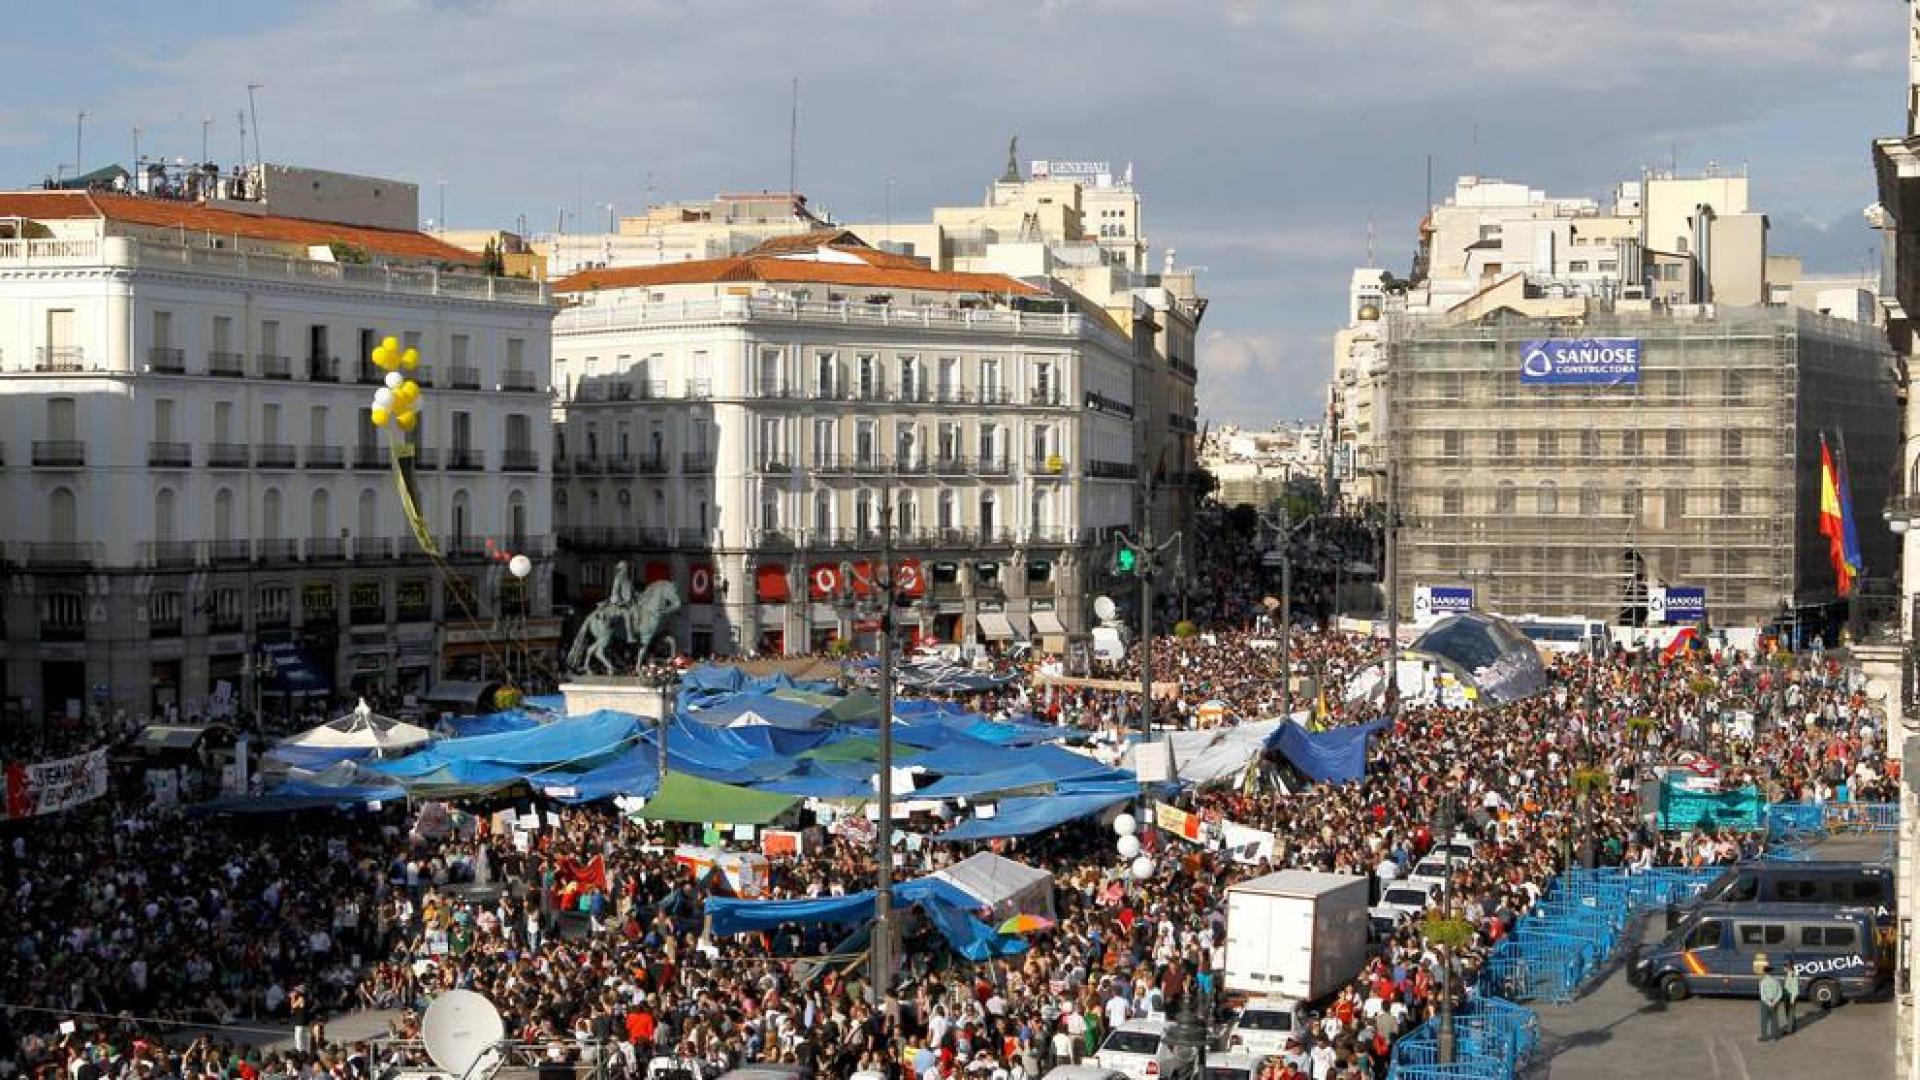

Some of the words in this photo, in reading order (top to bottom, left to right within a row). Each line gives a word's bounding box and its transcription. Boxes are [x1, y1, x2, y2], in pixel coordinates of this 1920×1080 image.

[1050, 162, 1110, 173] GENERALI
[1556, 348, 1636, 363] SANJOSE
[1556, 365, 1635, 373] CONSTRUCTORA
[1793, 955, 1864, 976] POLICIA
